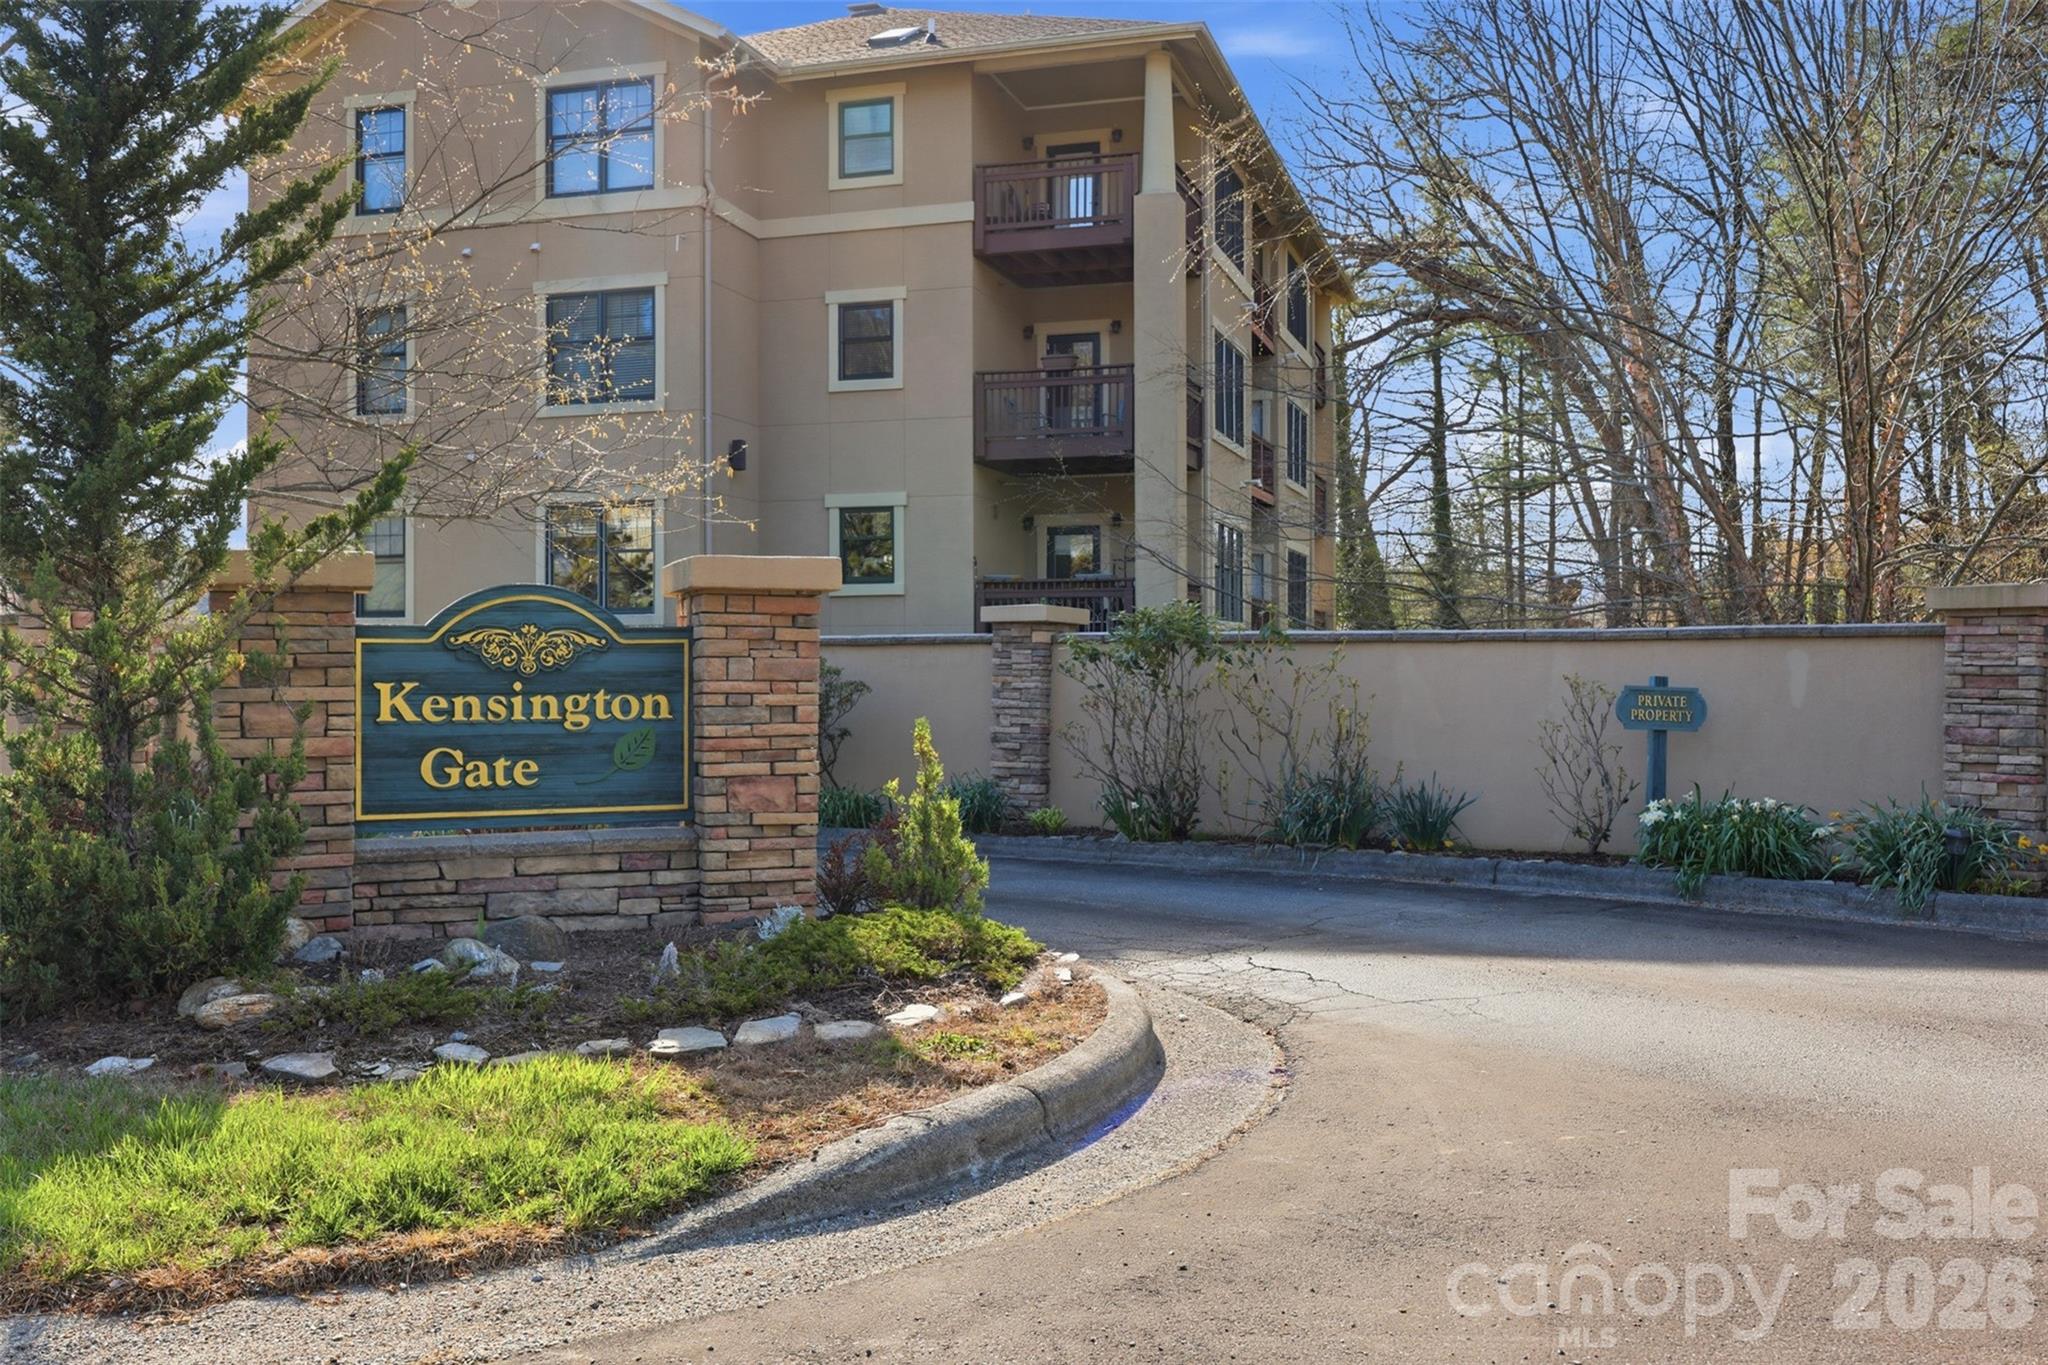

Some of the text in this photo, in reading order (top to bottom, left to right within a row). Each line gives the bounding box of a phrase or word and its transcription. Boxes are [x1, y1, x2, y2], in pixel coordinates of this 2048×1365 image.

[373, 681, 674, 731] Kensington
[1638, 694, 1687, 707] PRIVATE
[1631, 708, 1693, 722] PROPERTY
[420, 747, 539, 788] Gate
